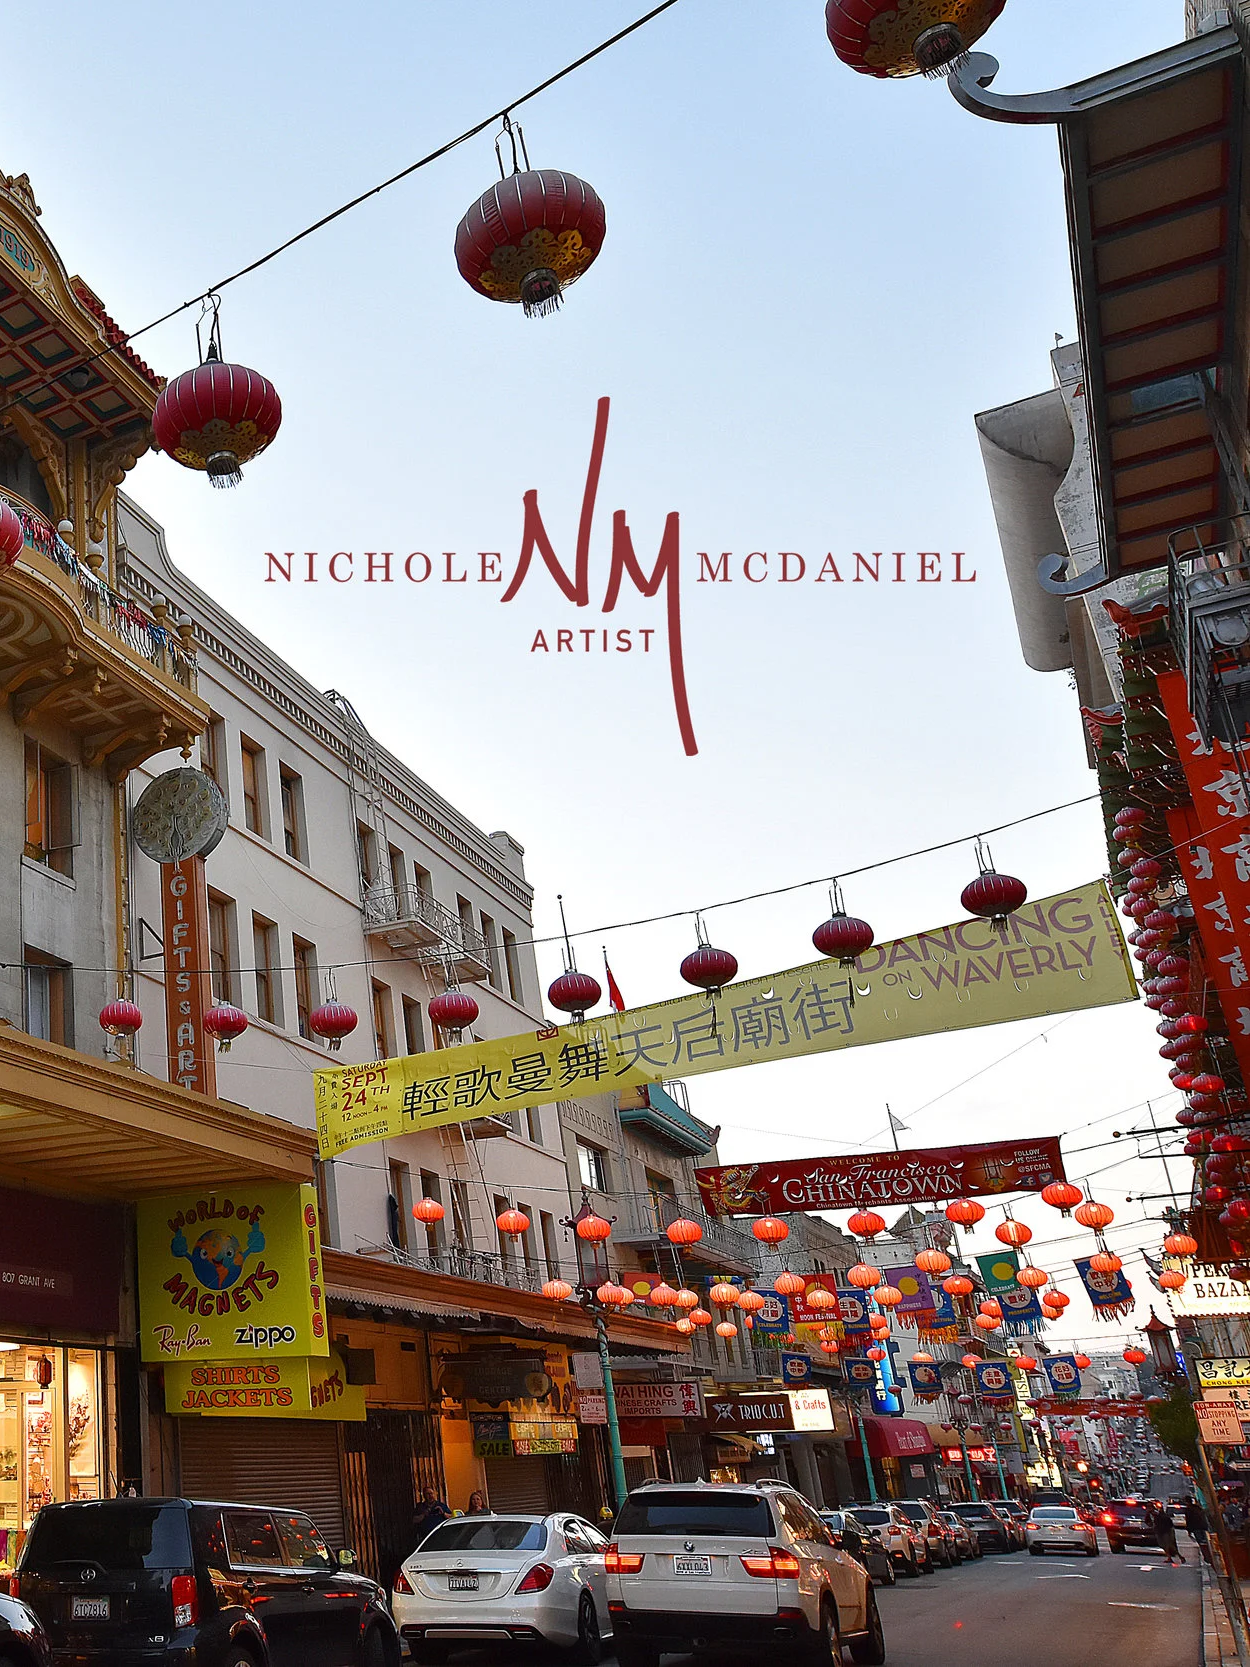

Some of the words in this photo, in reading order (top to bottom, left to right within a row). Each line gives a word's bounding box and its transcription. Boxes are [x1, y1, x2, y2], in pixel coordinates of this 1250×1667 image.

[170, 876, 192, 993] GIFTS
[855, 897, 1094, 974] DANCING
[883, 969, 912, 986] ON
[920, 936, 1096, 991] WAVERLY
[402, 980, 855, 1121] 輕歌曼舞天后廟街
[342, 1060, 387, 1077] SATURDAY
[342, 1067, 389, 1091] SEPT
[318, 1075, 330, 1149] 九月二十四日
[342, 1112, 351, 1122] 12
[336, 1139, 348, 1148] FREE
[350, 1126, 389, 1142] ADMISSION
[829, 1156, 882, 1166] WELCOME
[1013, 1148, 1040, 1157] FOLLOW
[806, 1167, 841, 1184] San
[849, 1163, 948, 1181] Francisco
[782, 1173, 963, 1204] CHINATOWN
[816, 1201, 853, 1209] Chinatown
[855, 1199, 892, 1207] Merchants
[894, 1195, 936, 1204] Association
[168, 1197, 234, 1232] WORLD
[236, 1204, 265, 1225] OF
[2, 1271, 15, 1283] 807
[18, 1274, 40, 1287] GRANT
[43, 1278, 55, 1289] AVE
[304, 1203, 324, 1338] GIFTS
[163, 1261, 279, 1316] MAGNETS
[191, 1365, 280, 1387] SHIRTS
[181, 1387, 293, 1409] JACKETS
[638, 1386, 673, 1399] HING
[624, 1407, 662, 1415] IMPORTS
[645, 1399, 677, 1407] CRAFTS
[803, 1399, 827, 1410] Crafts
[1198, 1409, 1209, 1419] NO
[1209, 1409, 1236, 1418] STOPPING
[1211, 1419, 1227, 1427] ANY
[1212, 1428, 1230, 1436] TIME
[479, 1441, 510, 1456] SALE
